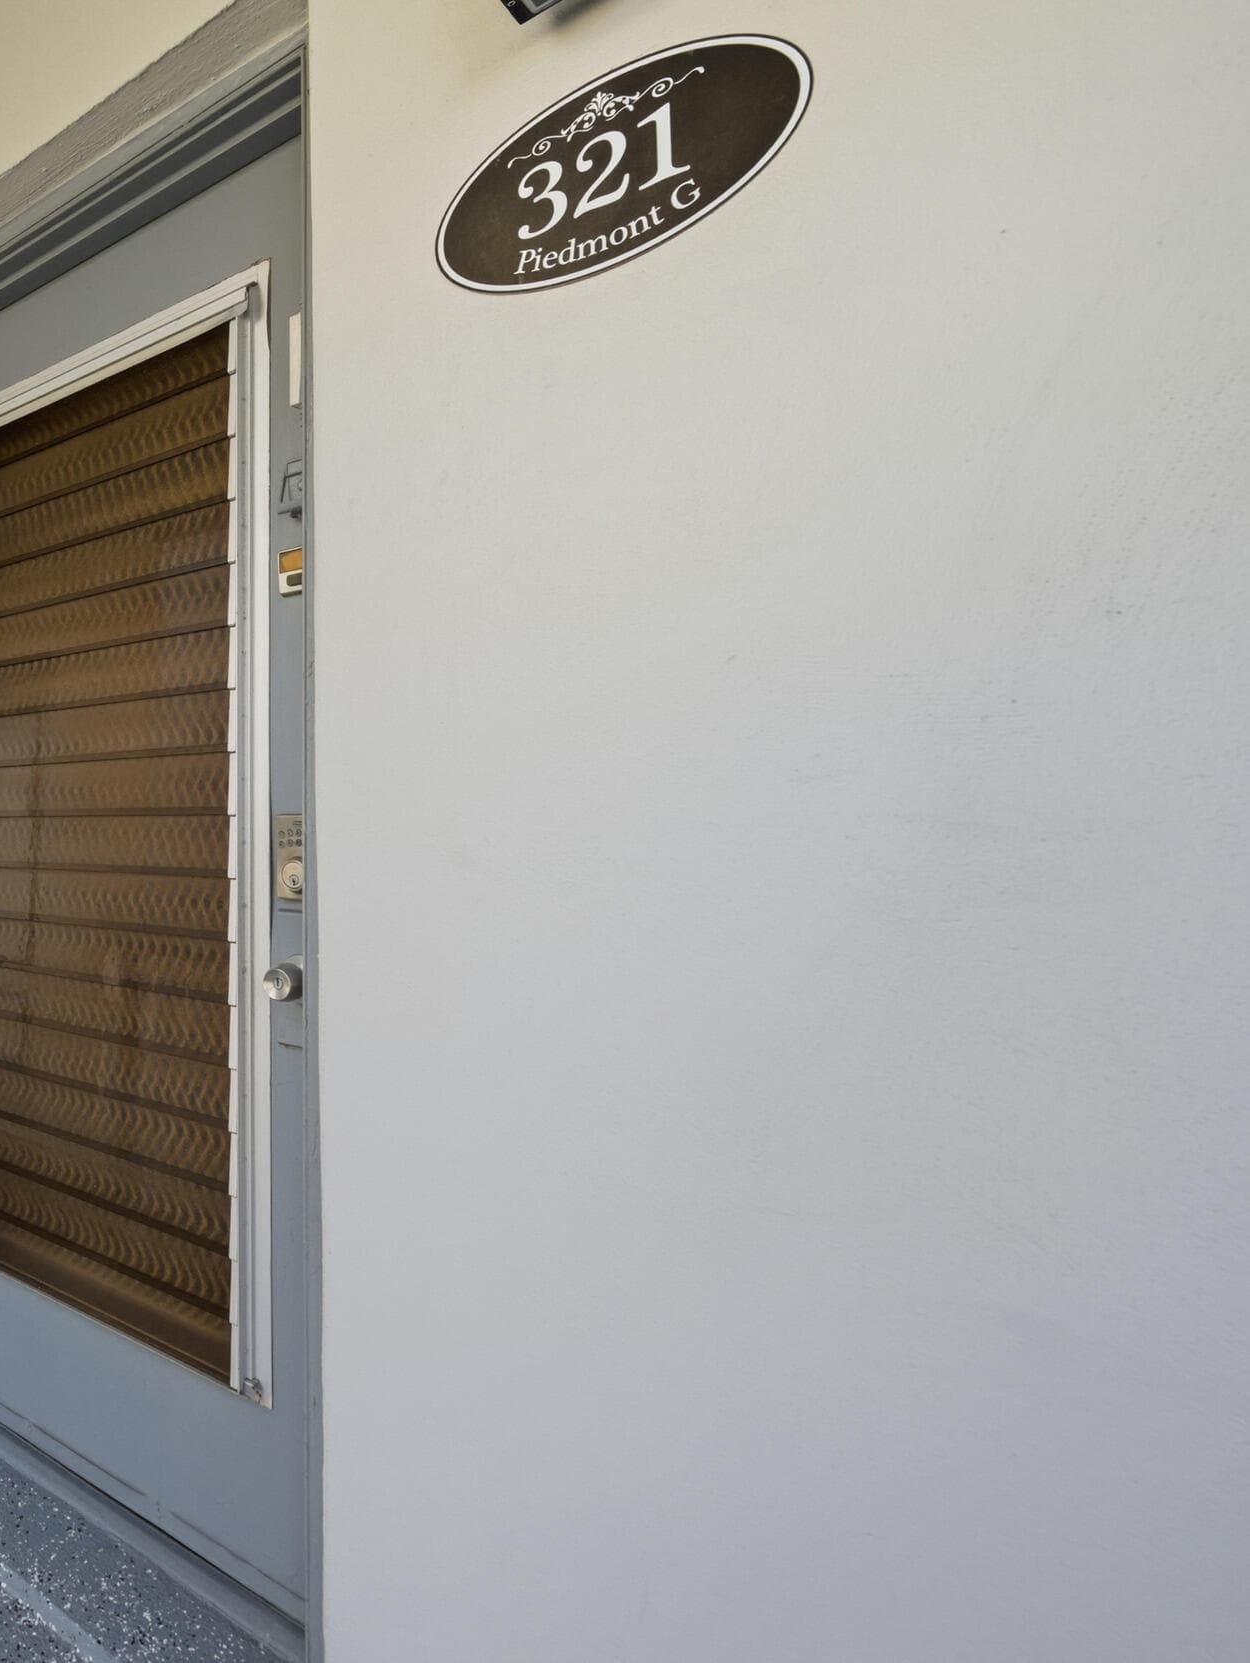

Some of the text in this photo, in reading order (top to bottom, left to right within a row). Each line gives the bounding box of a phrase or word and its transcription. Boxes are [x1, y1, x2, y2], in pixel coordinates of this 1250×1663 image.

[513, 178, 702, 275] Piedmont G
[517, 102, 691, 241] 321
